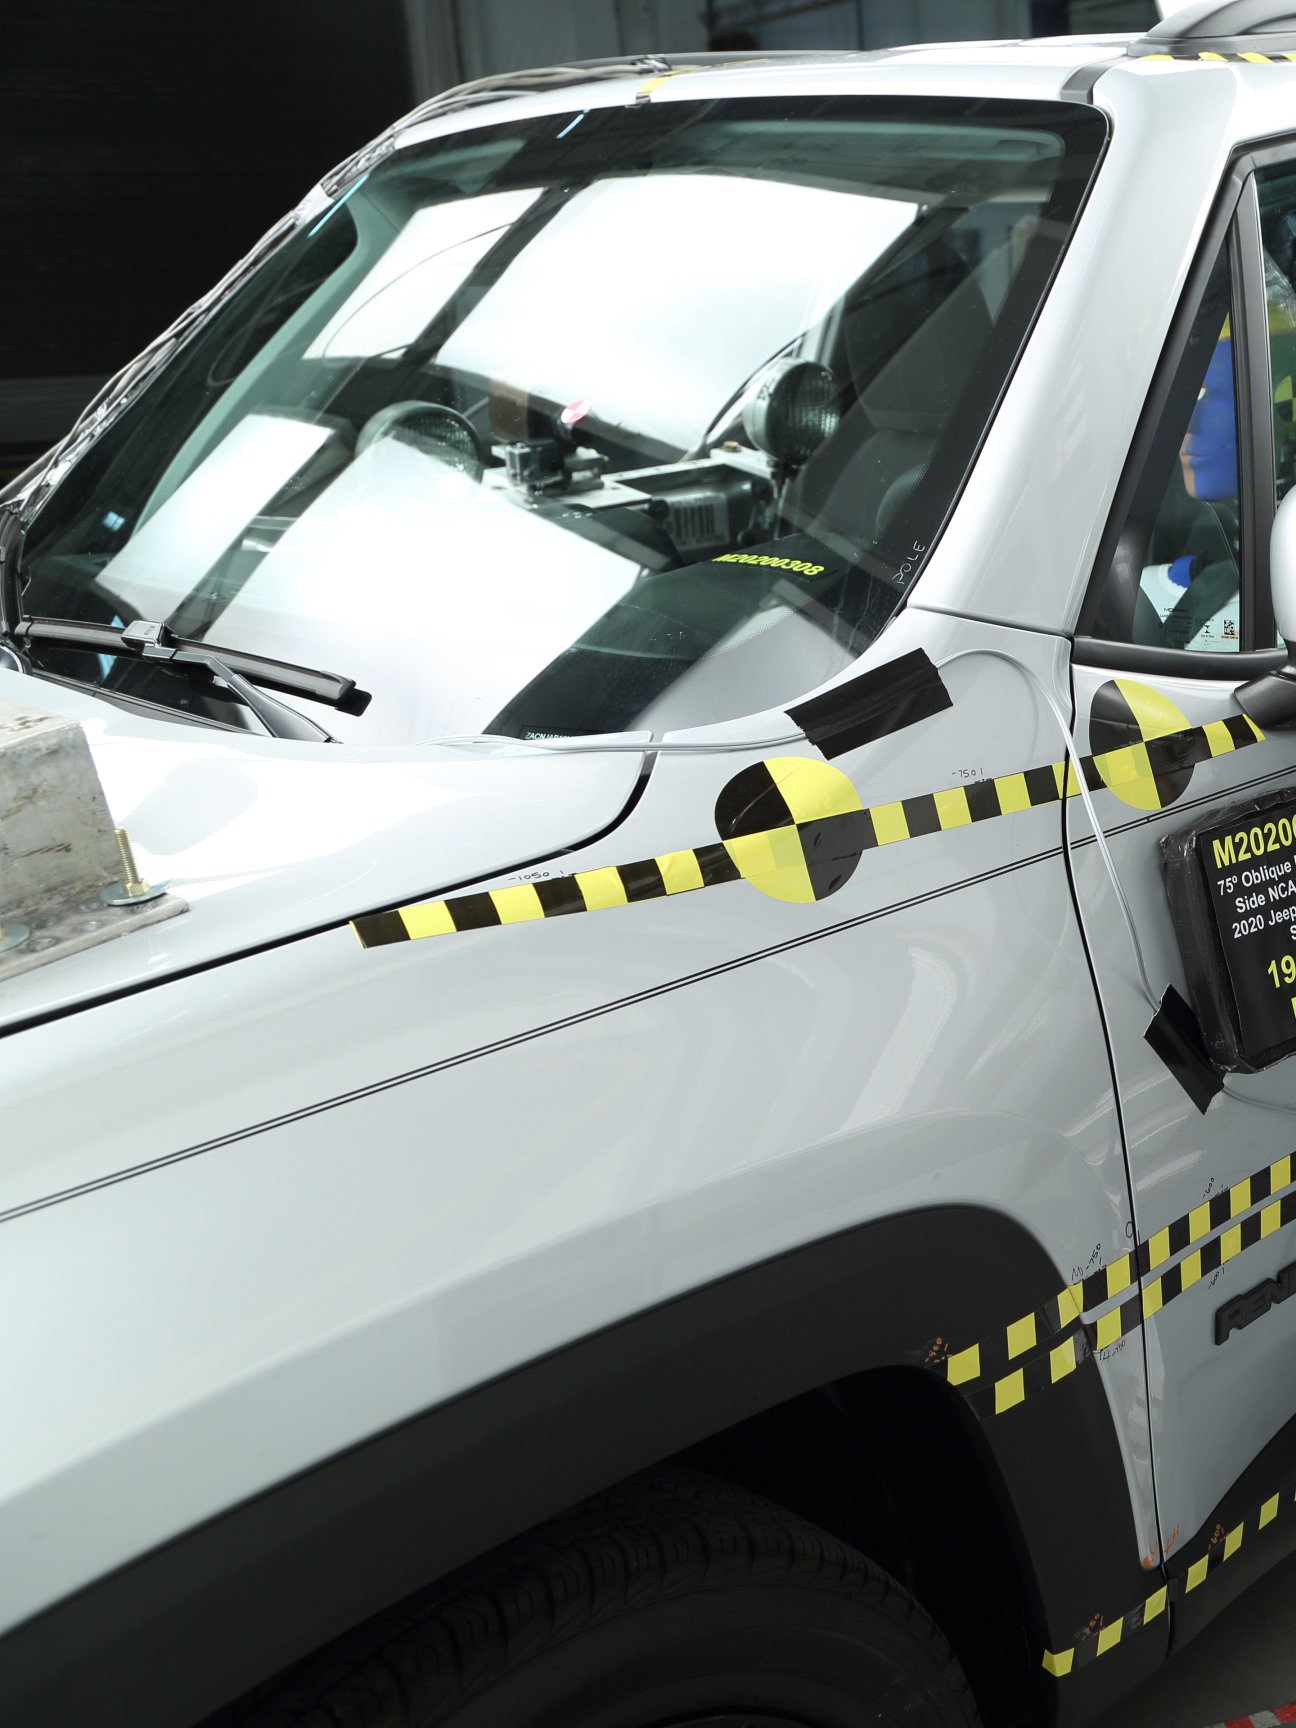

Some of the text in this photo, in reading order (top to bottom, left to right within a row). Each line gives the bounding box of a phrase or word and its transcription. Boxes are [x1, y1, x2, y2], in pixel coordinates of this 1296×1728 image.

[712, 553, 825, 577] M20200308
[892, 540, 926, 585] POLE
[508, 870, 550, 881] -1050
[1242, 860, 1292, 890] Oblique
[1235, 892, 1267, 914] Side
[1232, 917, 1265, 939] 2020
[1202, 1177, 1215, 1199] -600
